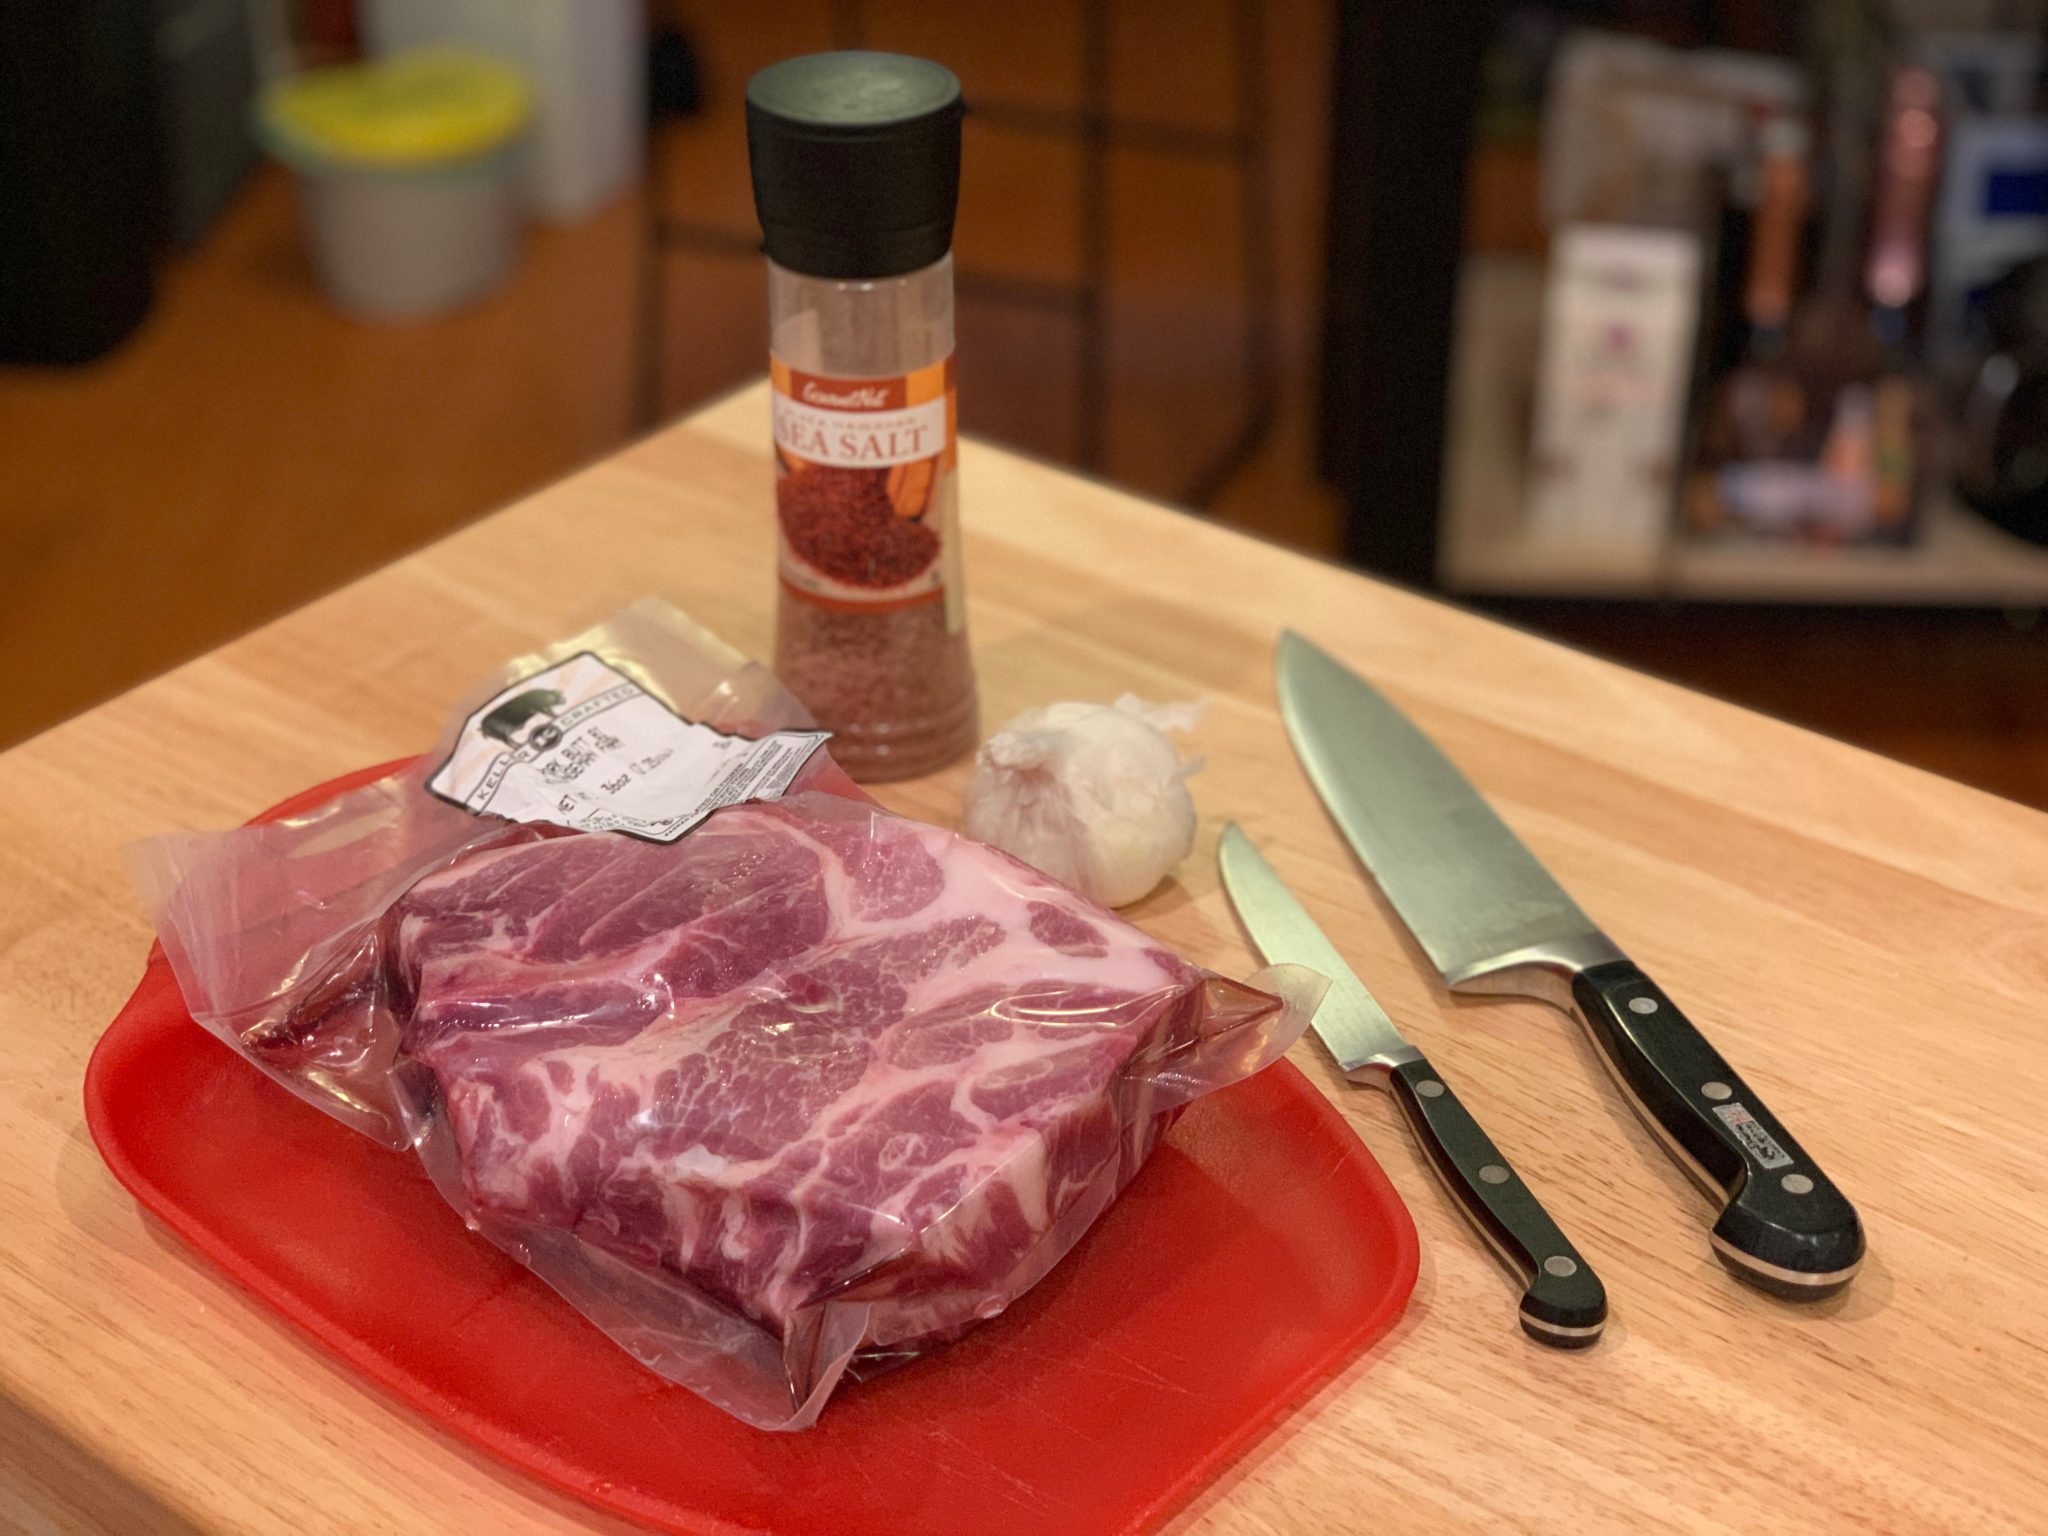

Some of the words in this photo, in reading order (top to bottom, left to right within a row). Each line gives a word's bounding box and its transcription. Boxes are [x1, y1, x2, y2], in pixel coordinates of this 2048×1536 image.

[775, 415, 830, 458] SEA
[840, 424, 928, 459] SALT
[477, 750, 530, 801] KELLR
[560, 686, 635, 727] CRAFTED
[561, 736, 590, 760] BUTT
